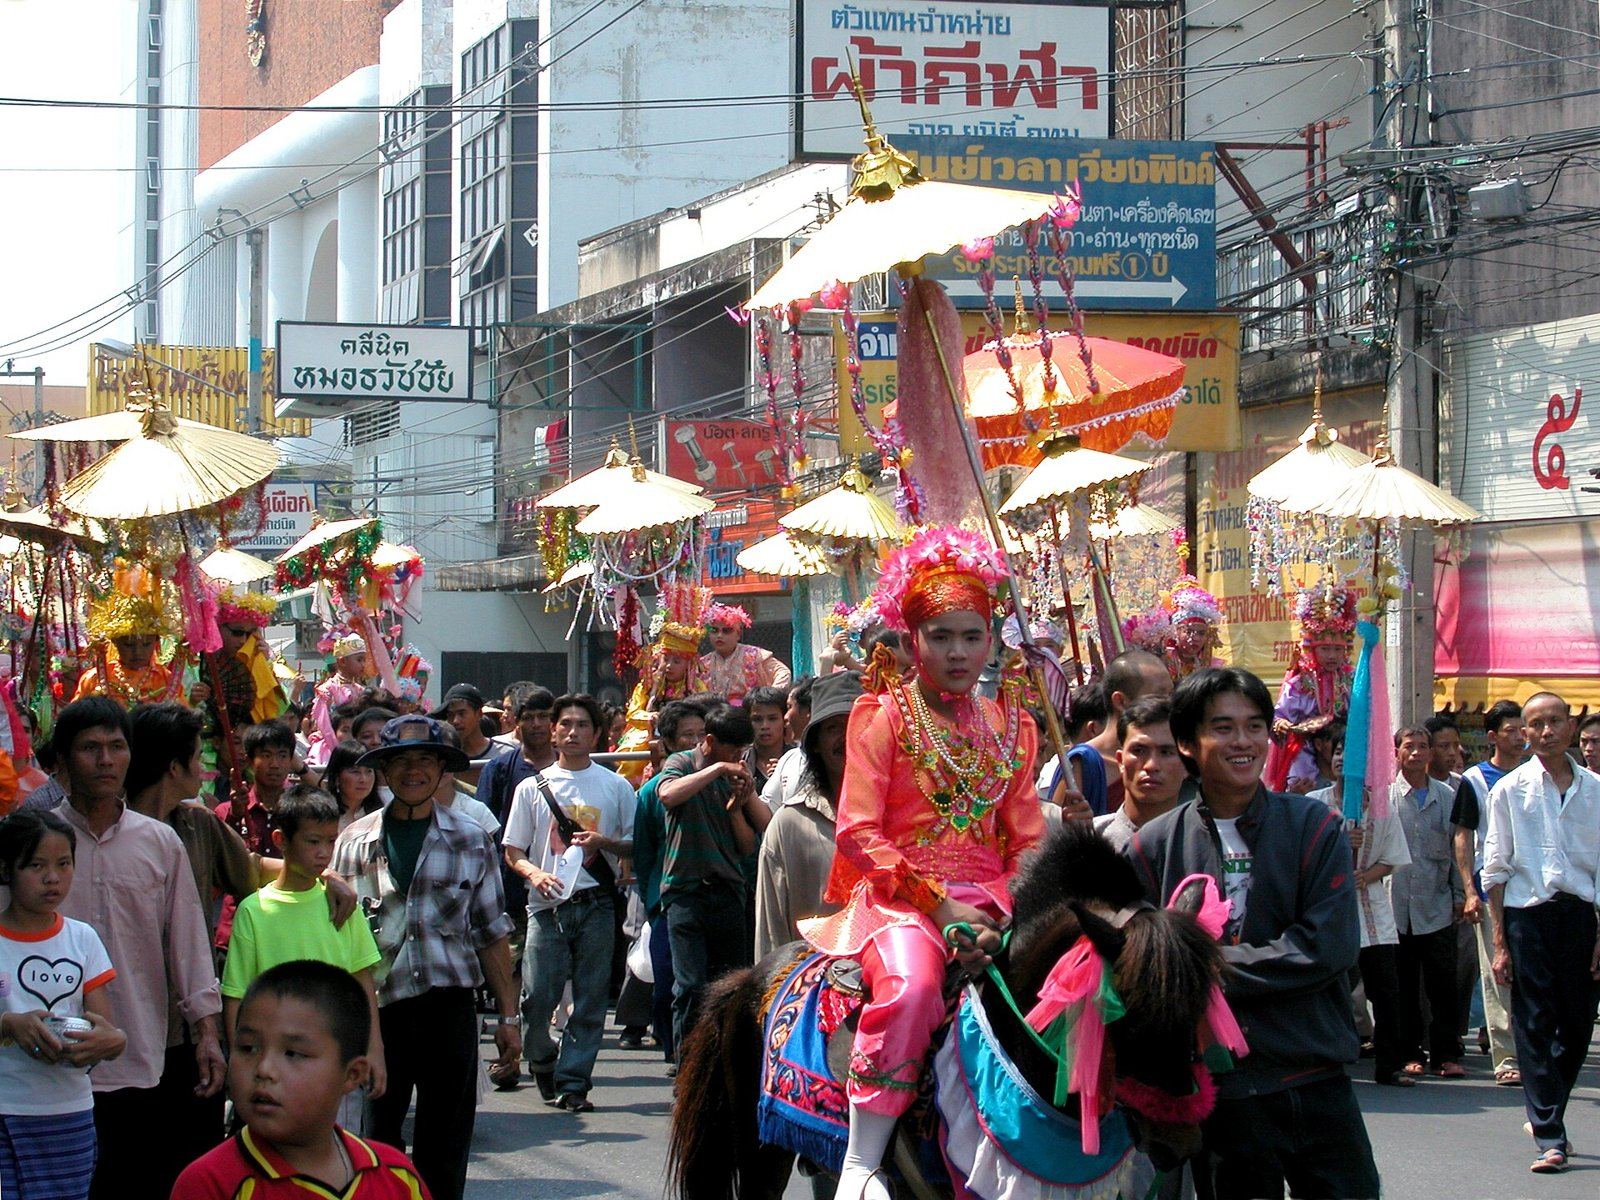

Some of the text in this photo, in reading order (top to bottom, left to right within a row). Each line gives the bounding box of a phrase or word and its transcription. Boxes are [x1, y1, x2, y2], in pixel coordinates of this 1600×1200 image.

[831, 6, 1011, 36] ตัวแทนจำหน่าย
[905, 145, 1215, 186] นย์เวลาเวียงพิงค์
[340, 330, 410, 357] คลีนิค
[293, 358, 454, 393] หมอธวัชชัย
[32, 970, 74, 984] love
